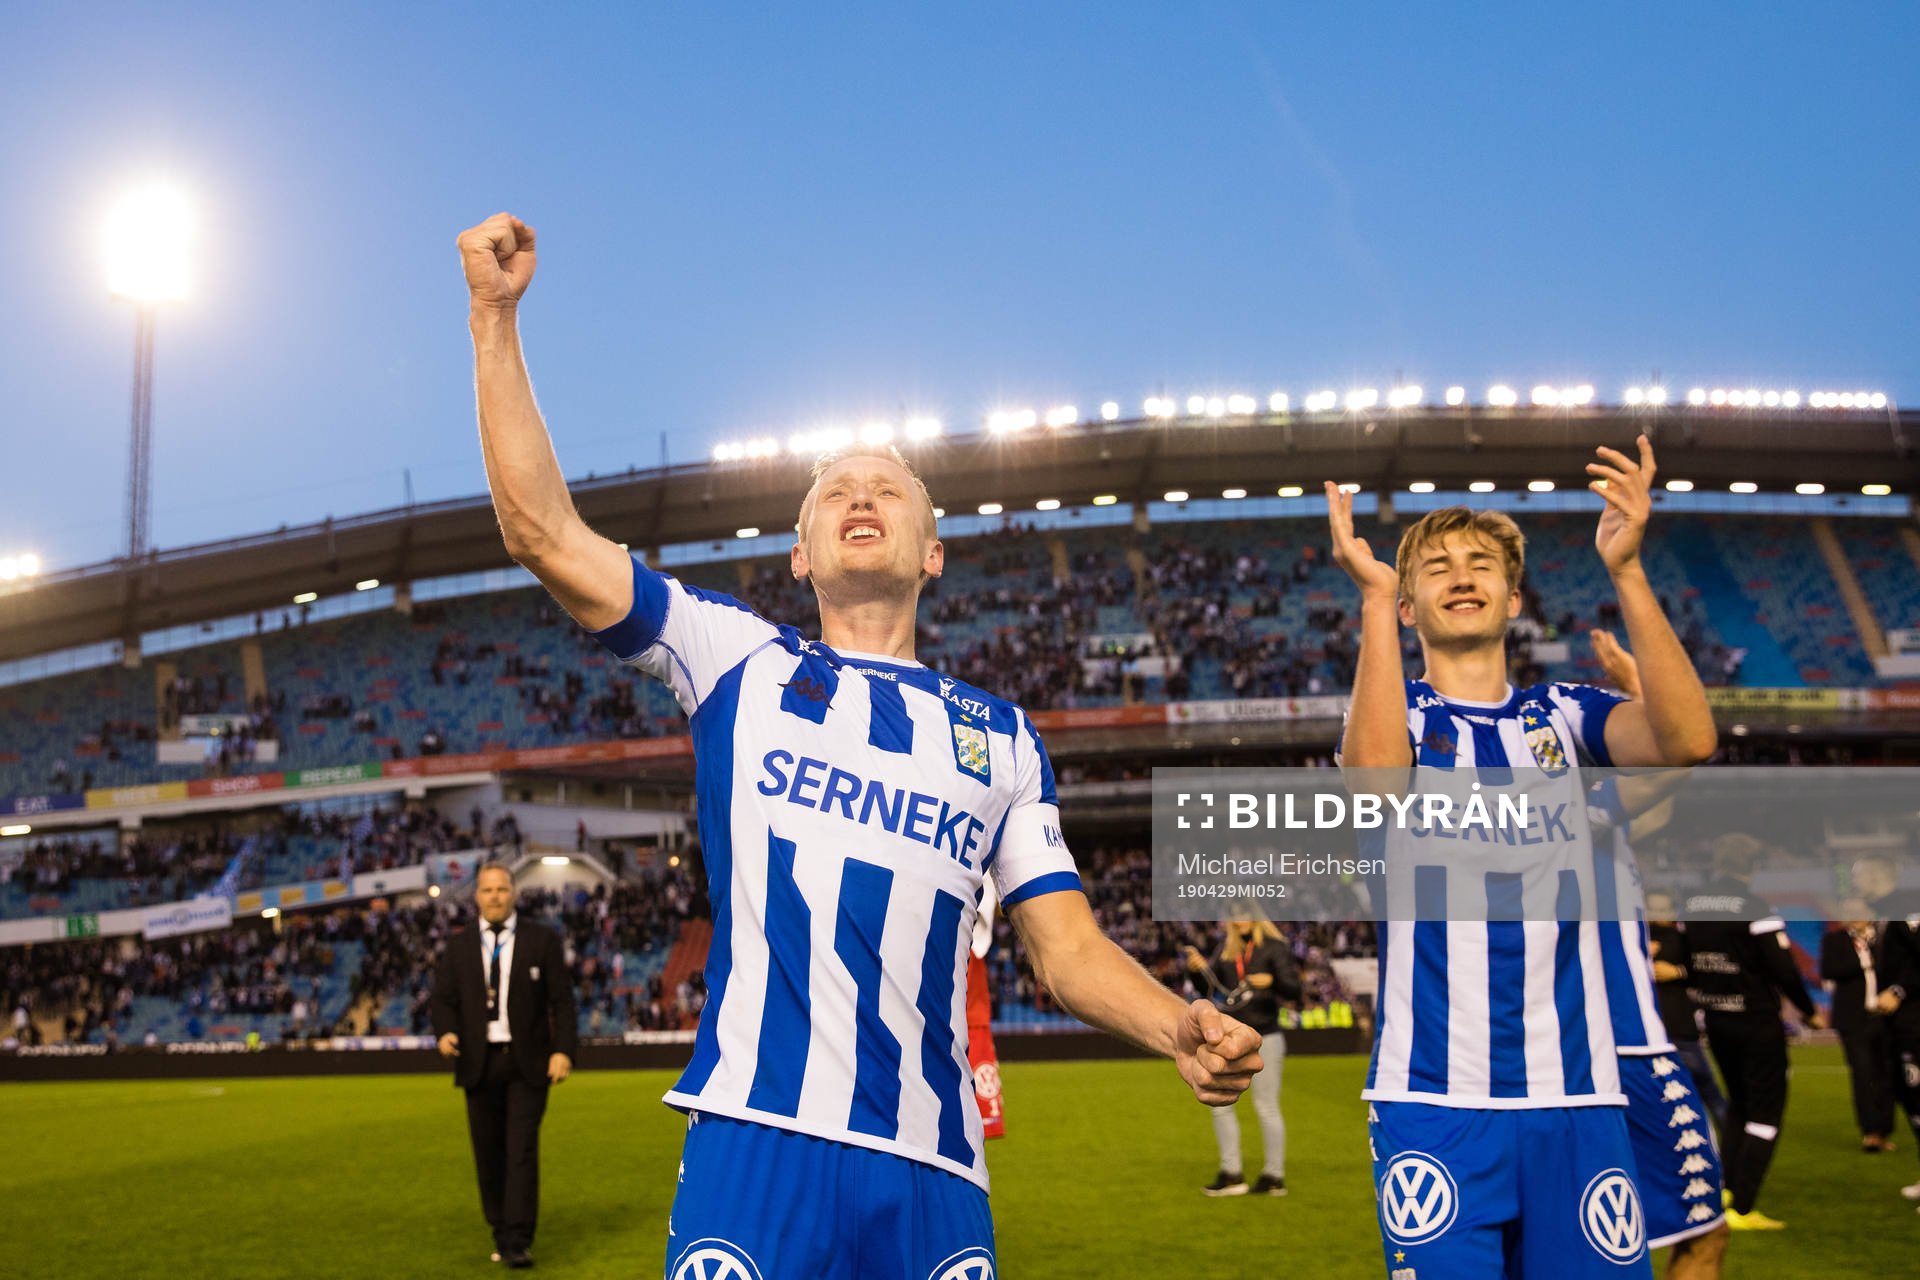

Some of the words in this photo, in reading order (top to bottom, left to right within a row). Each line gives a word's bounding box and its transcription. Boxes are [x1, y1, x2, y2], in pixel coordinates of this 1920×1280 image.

[856, 668, 898, 682] SERNEKE
[940, 689, 991, 721] RASTA
[756, 748, 986, 870] SERNEKE
[1383, 1158, 1452, 1237] VW
[1587, 1175, 1644, 1258] VW
